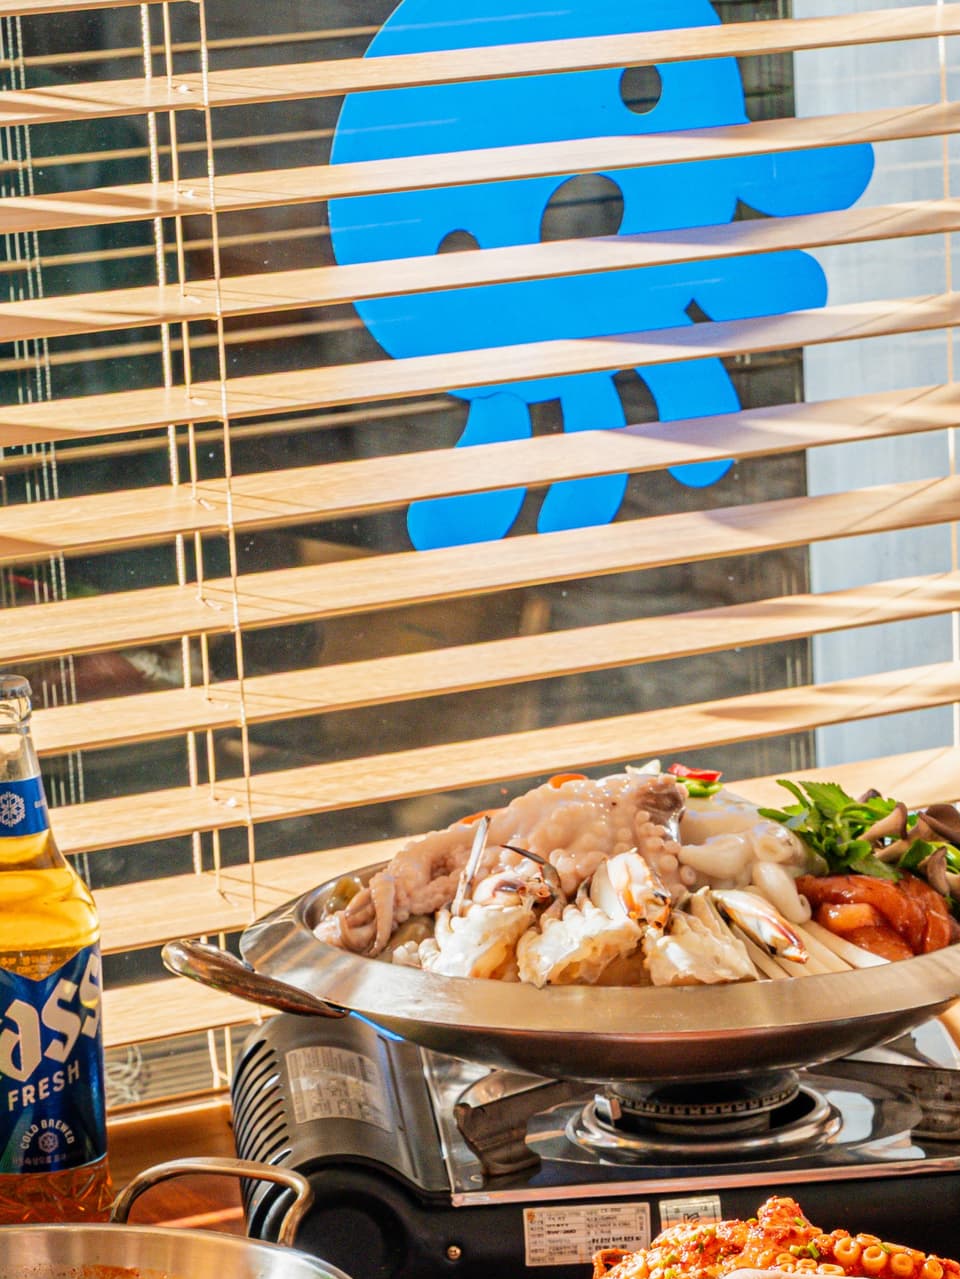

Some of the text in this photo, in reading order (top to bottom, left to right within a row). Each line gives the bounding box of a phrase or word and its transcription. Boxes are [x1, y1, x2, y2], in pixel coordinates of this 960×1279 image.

[0, 953, 99, 1083] ass
[7, 1059, 80, 1112] FRESH
[20, 1118, 76, 1150] COLD BREWED
